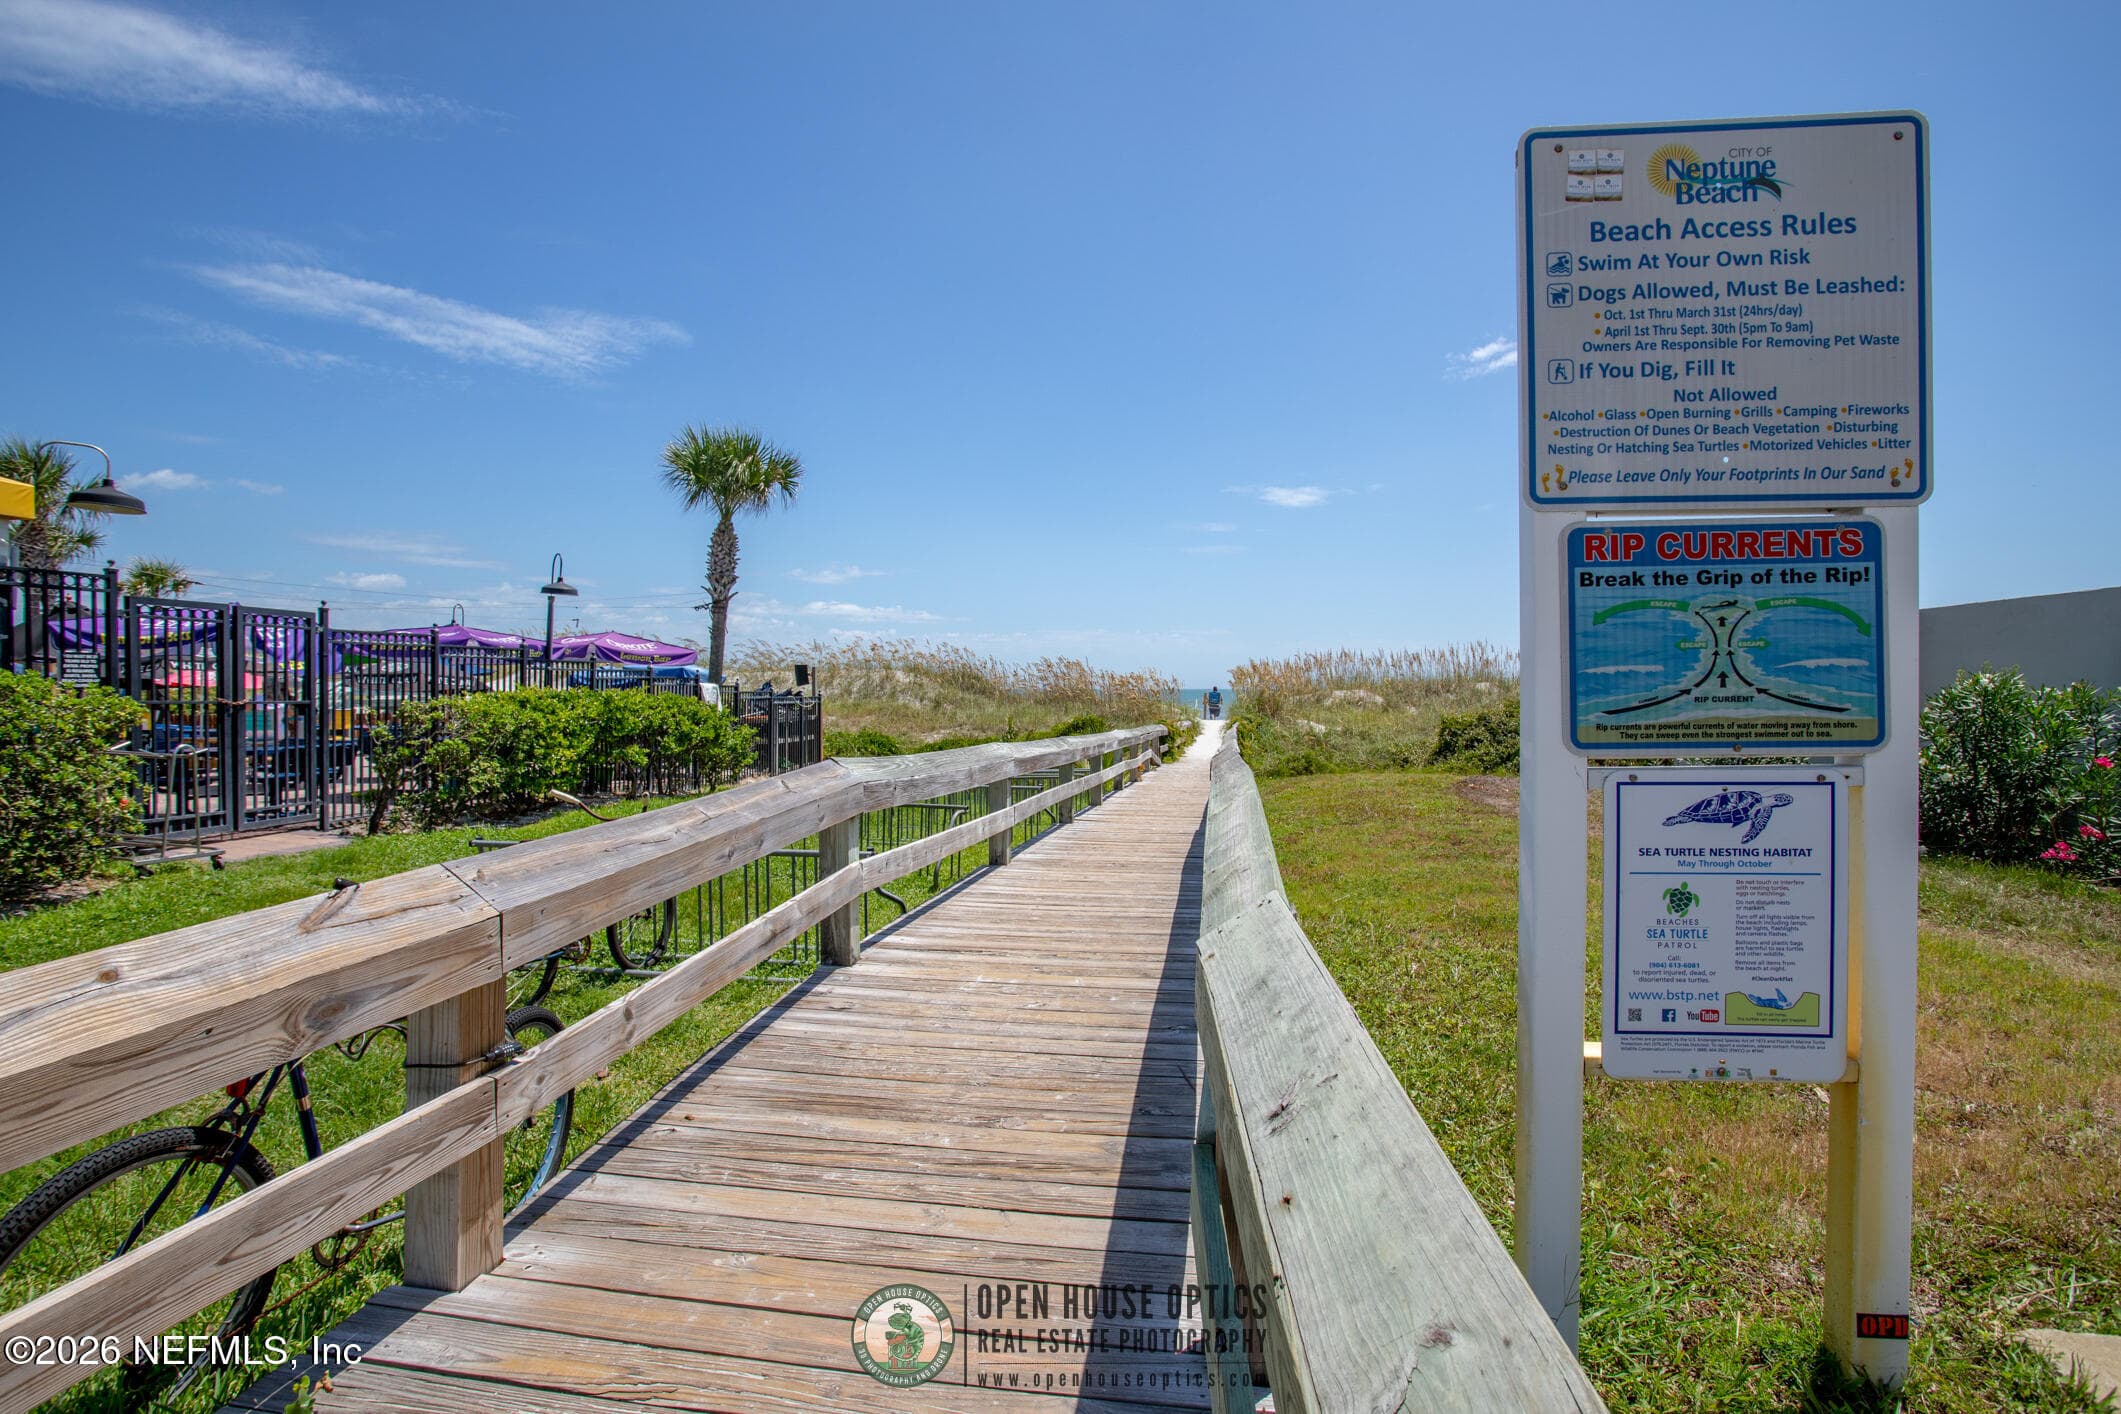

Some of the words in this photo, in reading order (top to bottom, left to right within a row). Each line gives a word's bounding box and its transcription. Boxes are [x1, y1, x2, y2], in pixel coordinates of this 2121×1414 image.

[1729, 148, 1752, 158] CITY
[1756, 147, 1772, 157] OF
[1666, 156, 1776, 186] Neptune
[1676, 179, 1758, 205] Beach
[1590, 218, 1672, 242] Beach
[1680, 216, 1773, 240] Access
[1782, 212, 1857, 236] Rules
[1578, 254, 1632, 271] Swim
[1638, 254, 1660, 270] At
[1666, 252, 1710, 268] Your
[1717, 250, 1762, 267] Own
[1770, 248, 1810, 265] Risk
[1578, 286, 1626, 304] Dogs
[1632, 280, 1720, 300] Allowed,
[1727, 280, 1778, 296] Must
[1785, 279, 1810, 295] Be
[1816, 275, 1905, 294] Leashed:
[1604, 309, 1626, 320] Oct.
[1630, 308, 1645, 320] 1st
[1648, 308, 1672, 319] Thru
[1676, 306, 1710, 318] March
[1714, 306, 1736, 317] 31st
[1739, 304, 1802, 318] (24hrs/day)
[1604, 325, 1630, 340] April
[1634, 325, 1650, 336] 1st
[1652, 324, 1678, 336] Thru
[1680, 324, 1708, 337] Sept.
[1711, 323, 1736, 334] 30th
[1739, 322, 1767, 336] (5pm
[1770, 322, 1782, 332] To
[1786, 320, 1814, 334] 9am)
[1582, 341, 1631, 352] Owners
[1634, 340, 1656, 350] Are
[1661, 337, 1738, 352] Responsible
[1742, 337, 1762, 348] For
[1766, 336, 1830, 349] Removing
[1834, 335, 1856, 346] Pet
[1859, 334, 1900, 346] Waste
[1580, 362, 1593, 379] If
[1598, 362, 1634, 378] You
[1641, 361, 1678, 380] Dig,
[1686, 360, 1714, 376] Fill
[1722, 360, 1736, 376] It
[1674, 389, 1704, 402] Not
[1708, 386, 1777, 402] Allowed
[1549, 409, 1594, 422] Alcohol
[1604, 409, 1636, 420] Glass
[1646, 408, 1680, 421] Open
[1684, 407, 1732, 420] Burning
[1741, 406, 1773, 418] Grills
[1783, 405, 1838, 418] Camping
[1848, 404, 1910, 416] Fireworks
[1560, 426, 1630, 438] Destruction
[1634, 425, 1648, 436] Of
[1652, 424, 1690, 436] Dunes
[1694, 424, 1708, 436] Or
[1713, 423, 1749, 434] Beach
[1753, 422, 1820, 436] Vegetation
[1834, 421, 1898, 434] Disturbing
[1548, 443, 1593, 456] Nesting
[1597, 443, 1612, 454] Or
[1616, 442, 1670, 455] Hatching
[1673, 442, 1694, 452] Sea
[1697, 440, 1740, 452] Turtles
[1750, 438, 1814, 450] Motorized
[1816, 438, 1868, 450] Vehicles
[1878, 438, 1911, 449] Litter
[1568, 470, 1612, 484] Please
[1616, 470, 1656, 482] Leave
[1660, 468, 1691, 485] Only
[1696, 468, 1726, 482] Your
[1729, 466, 1799, 484] Footprints
[1804, 466, 1816, 480] In
[1820, 466, 1847, 480] Our
[1851, 465, 1886, 479] Sand
[1583, 533, 1645, 562] RIP
[1656, 528, 1864, 560] CURRENTS
[1580, 572, 1645, 588] Break
[1652, 570, 1688, 586] the
[1696, 570, 1743, 588] Grip
[1750, 568, 1772, 584] of
[1780, 568, 1816, 584] the
[1826, 566, 1870, 586] Rip!
[1596, 724, 1608, 732] Rip
[1658, 722, 1690, 732] powerful
[1692, 722, 1724, 730] currents
[1727, 722, 1734, 730] of
[1737, 722, 1758, 730] water
[1760, 722, 1788, 730] moving
[1790, 722, 1810, 730] away
[1620, 732, 1638, 740] They
[1656, 732, 1680, 740] sweep
[1716, 731, 1752, 740] strongest
[1754, 730, 1788, 738] swimmer
[1791, 730, 1804, 738] out
[1638, 848, 1660, 857] SEA
[1664, 848, 1706, 857] TURTLE
[1709, 848, 1760, 858] NESTING
[1764, 848, 1812, 858] HABITAT
[1678, 860, 1696, 868] May
[1700, 860, 1735, 868] Through
[1738, 860, 1772, 868] October
[1656, 918, 1700, 926] BEACHES
[1646, 928, 1666, 938] SEA
[1670, 928, 1708, 939] TURTLE
[1628, 988, 1720, 1003] www.bstp.net
[1686, 1010, 1720, 1022] YouTube
